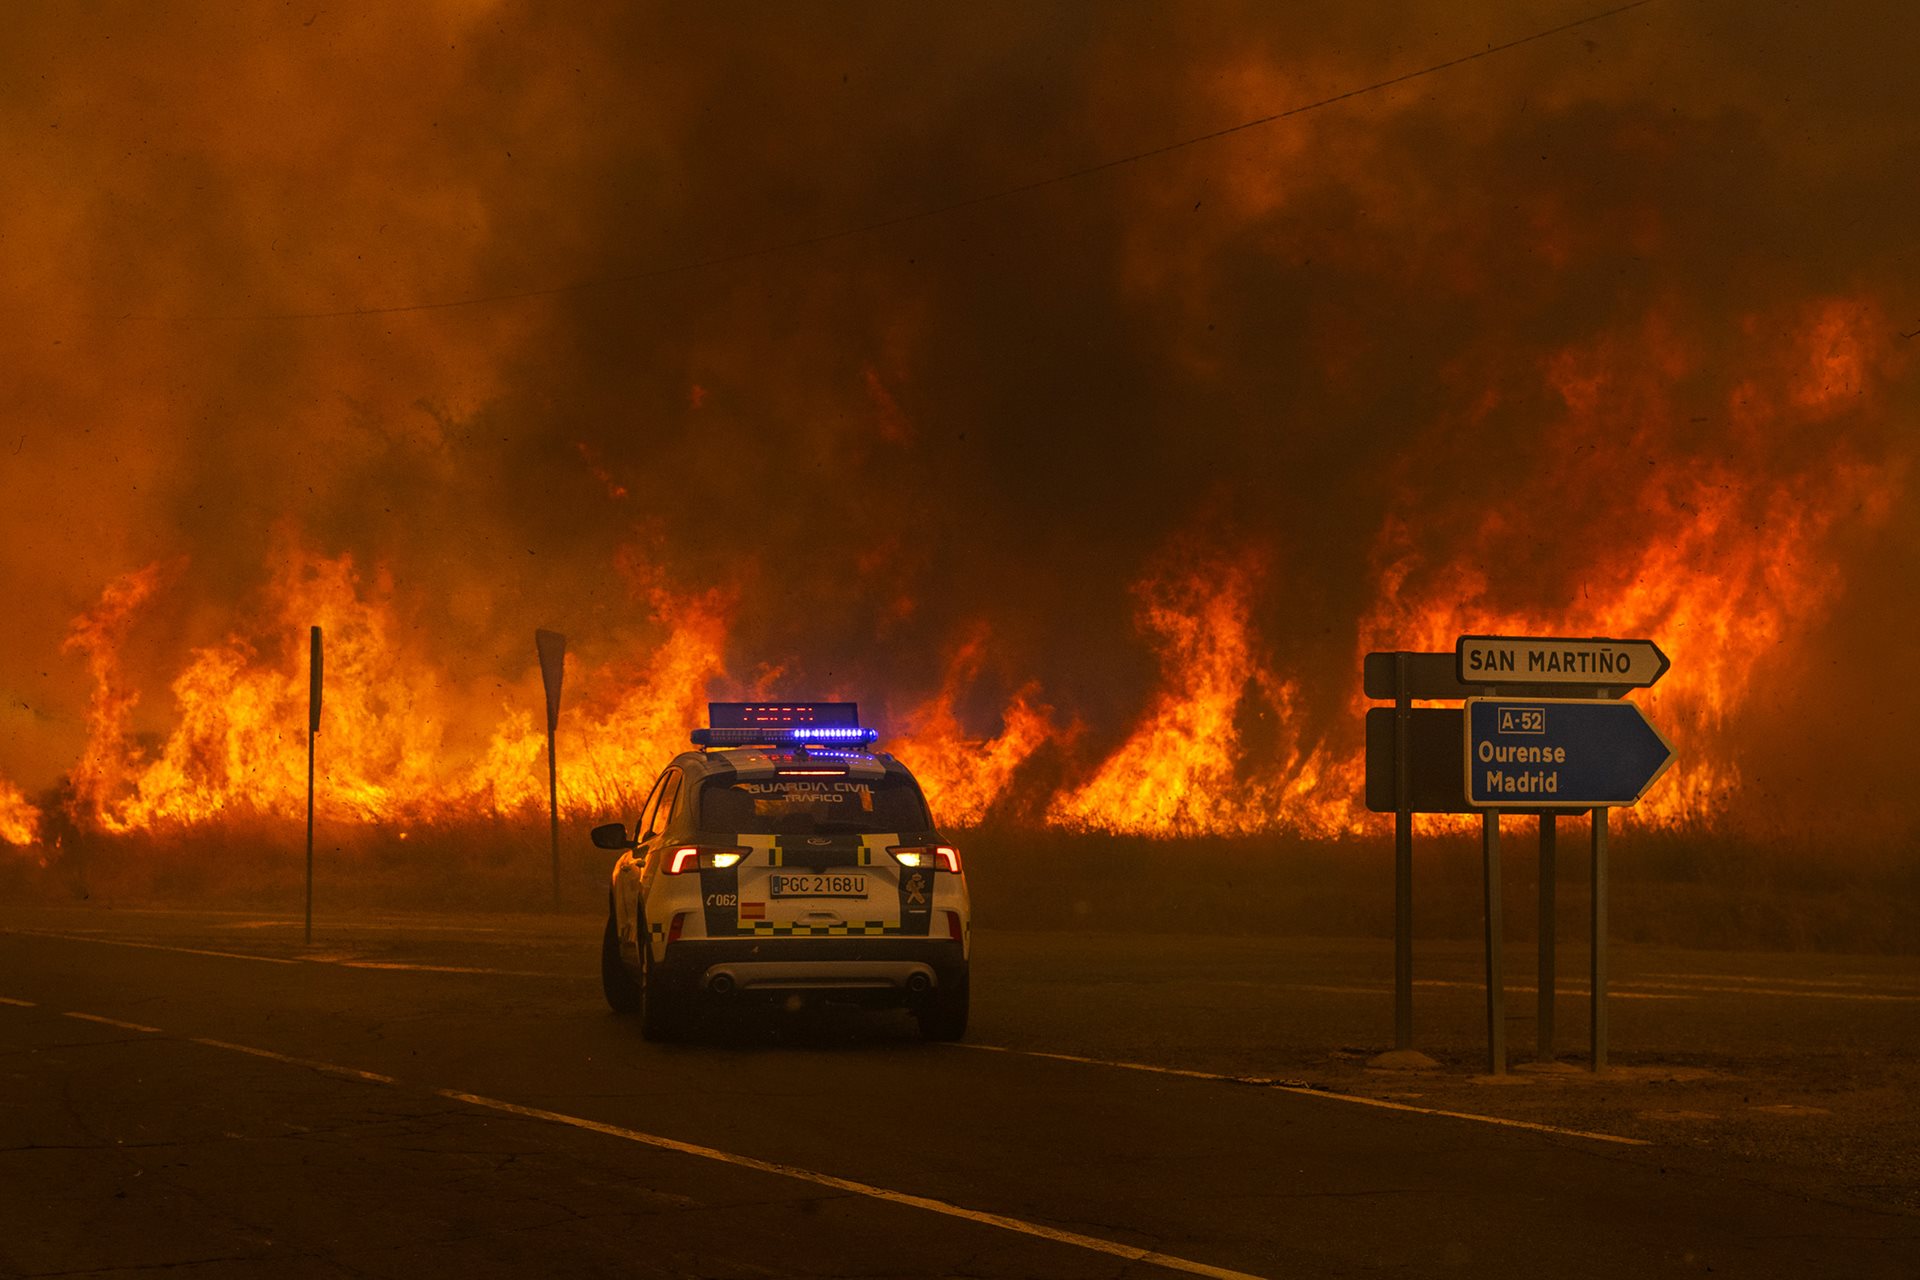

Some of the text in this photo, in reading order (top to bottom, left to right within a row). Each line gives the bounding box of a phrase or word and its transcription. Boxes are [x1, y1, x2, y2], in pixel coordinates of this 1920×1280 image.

[1470, 649, 1630, 673] SAN MARTIÑO
[1502, 712, 1541, 730] A-52
[1479, 741, 1565, 762] Ourense
[748, 782, 875, 794] GUARDIA CIVIL
[1487, 771, 1557, 792] Madrid
[781, 877, 809, 892] PGC
[716, 894, 737, 906] 062
